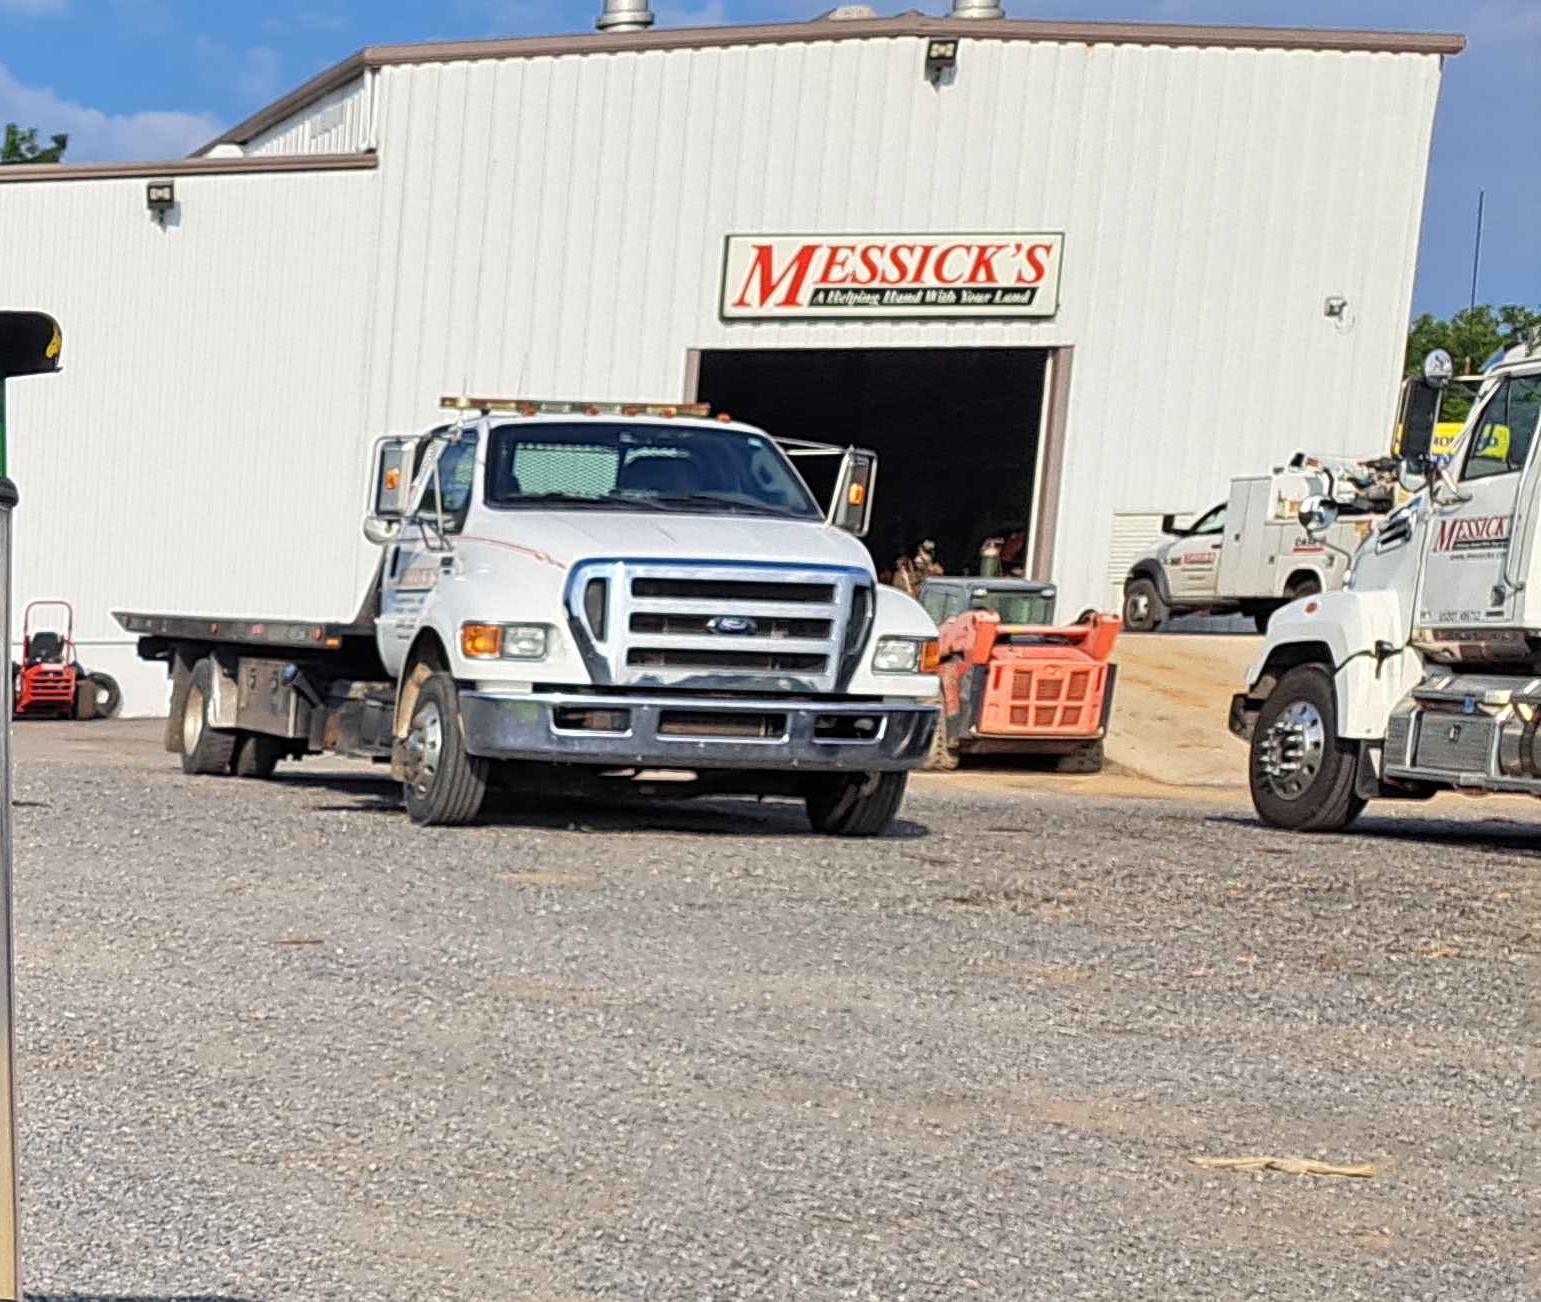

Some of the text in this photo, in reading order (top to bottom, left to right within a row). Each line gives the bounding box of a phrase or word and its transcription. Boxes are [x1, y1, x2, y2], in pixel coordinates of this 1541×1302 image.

[732, 242, 1053, 308] MESSICK'S
[813, 288, 1032, 306] A Helping Hand With Your Land
